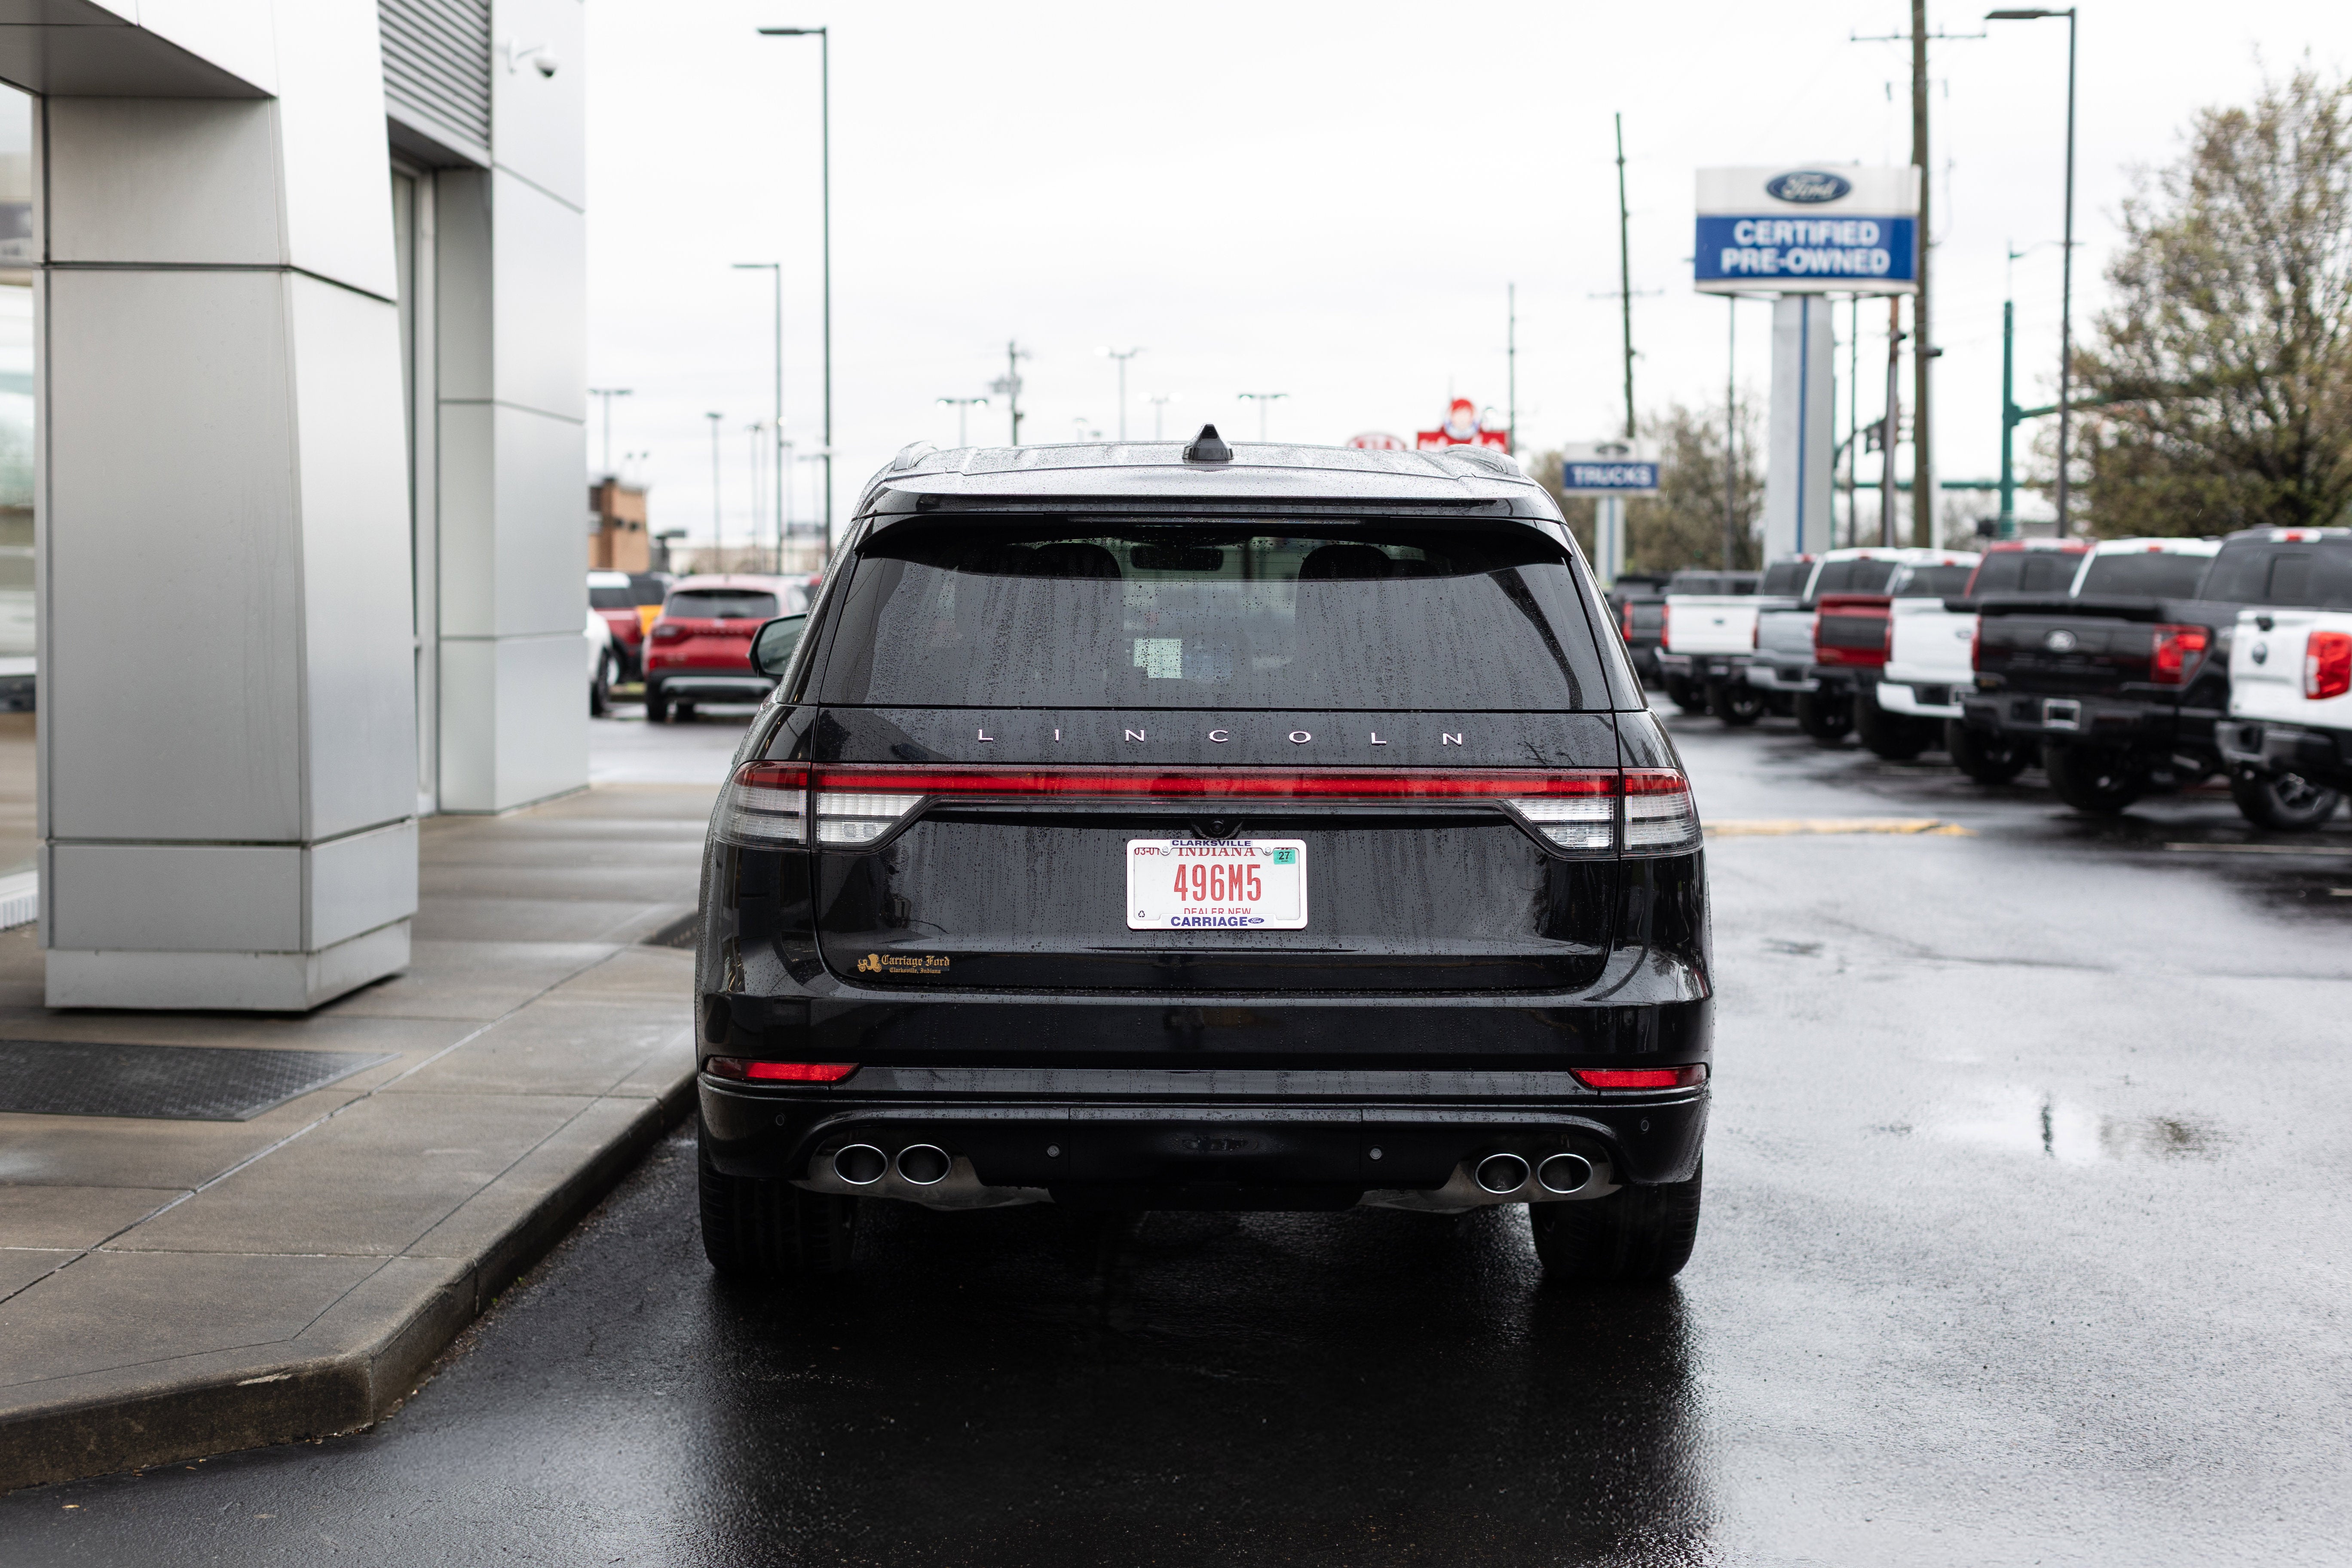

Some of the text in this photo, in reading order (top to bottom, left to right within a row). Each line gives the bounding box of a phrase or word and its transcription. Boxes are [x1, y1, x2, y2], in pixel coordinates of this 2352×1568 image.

[1779, 172, 1840, 200] Ford
[1734, 220, 1880, 247] CERTIFIED
[1721, 248, 1891, 275] PRE-OWNED
[978, 729, 1461, 745] LINCOLN
[1178, 848, 1256, 856] INDIANA
[1279, 851, 1290, 860] 27
[1174, 864, 1261, 901] 496M5
[1170, 916, 1248, 926] CARRIAGE
[882, 954, 950, 967] Carriage Ford
